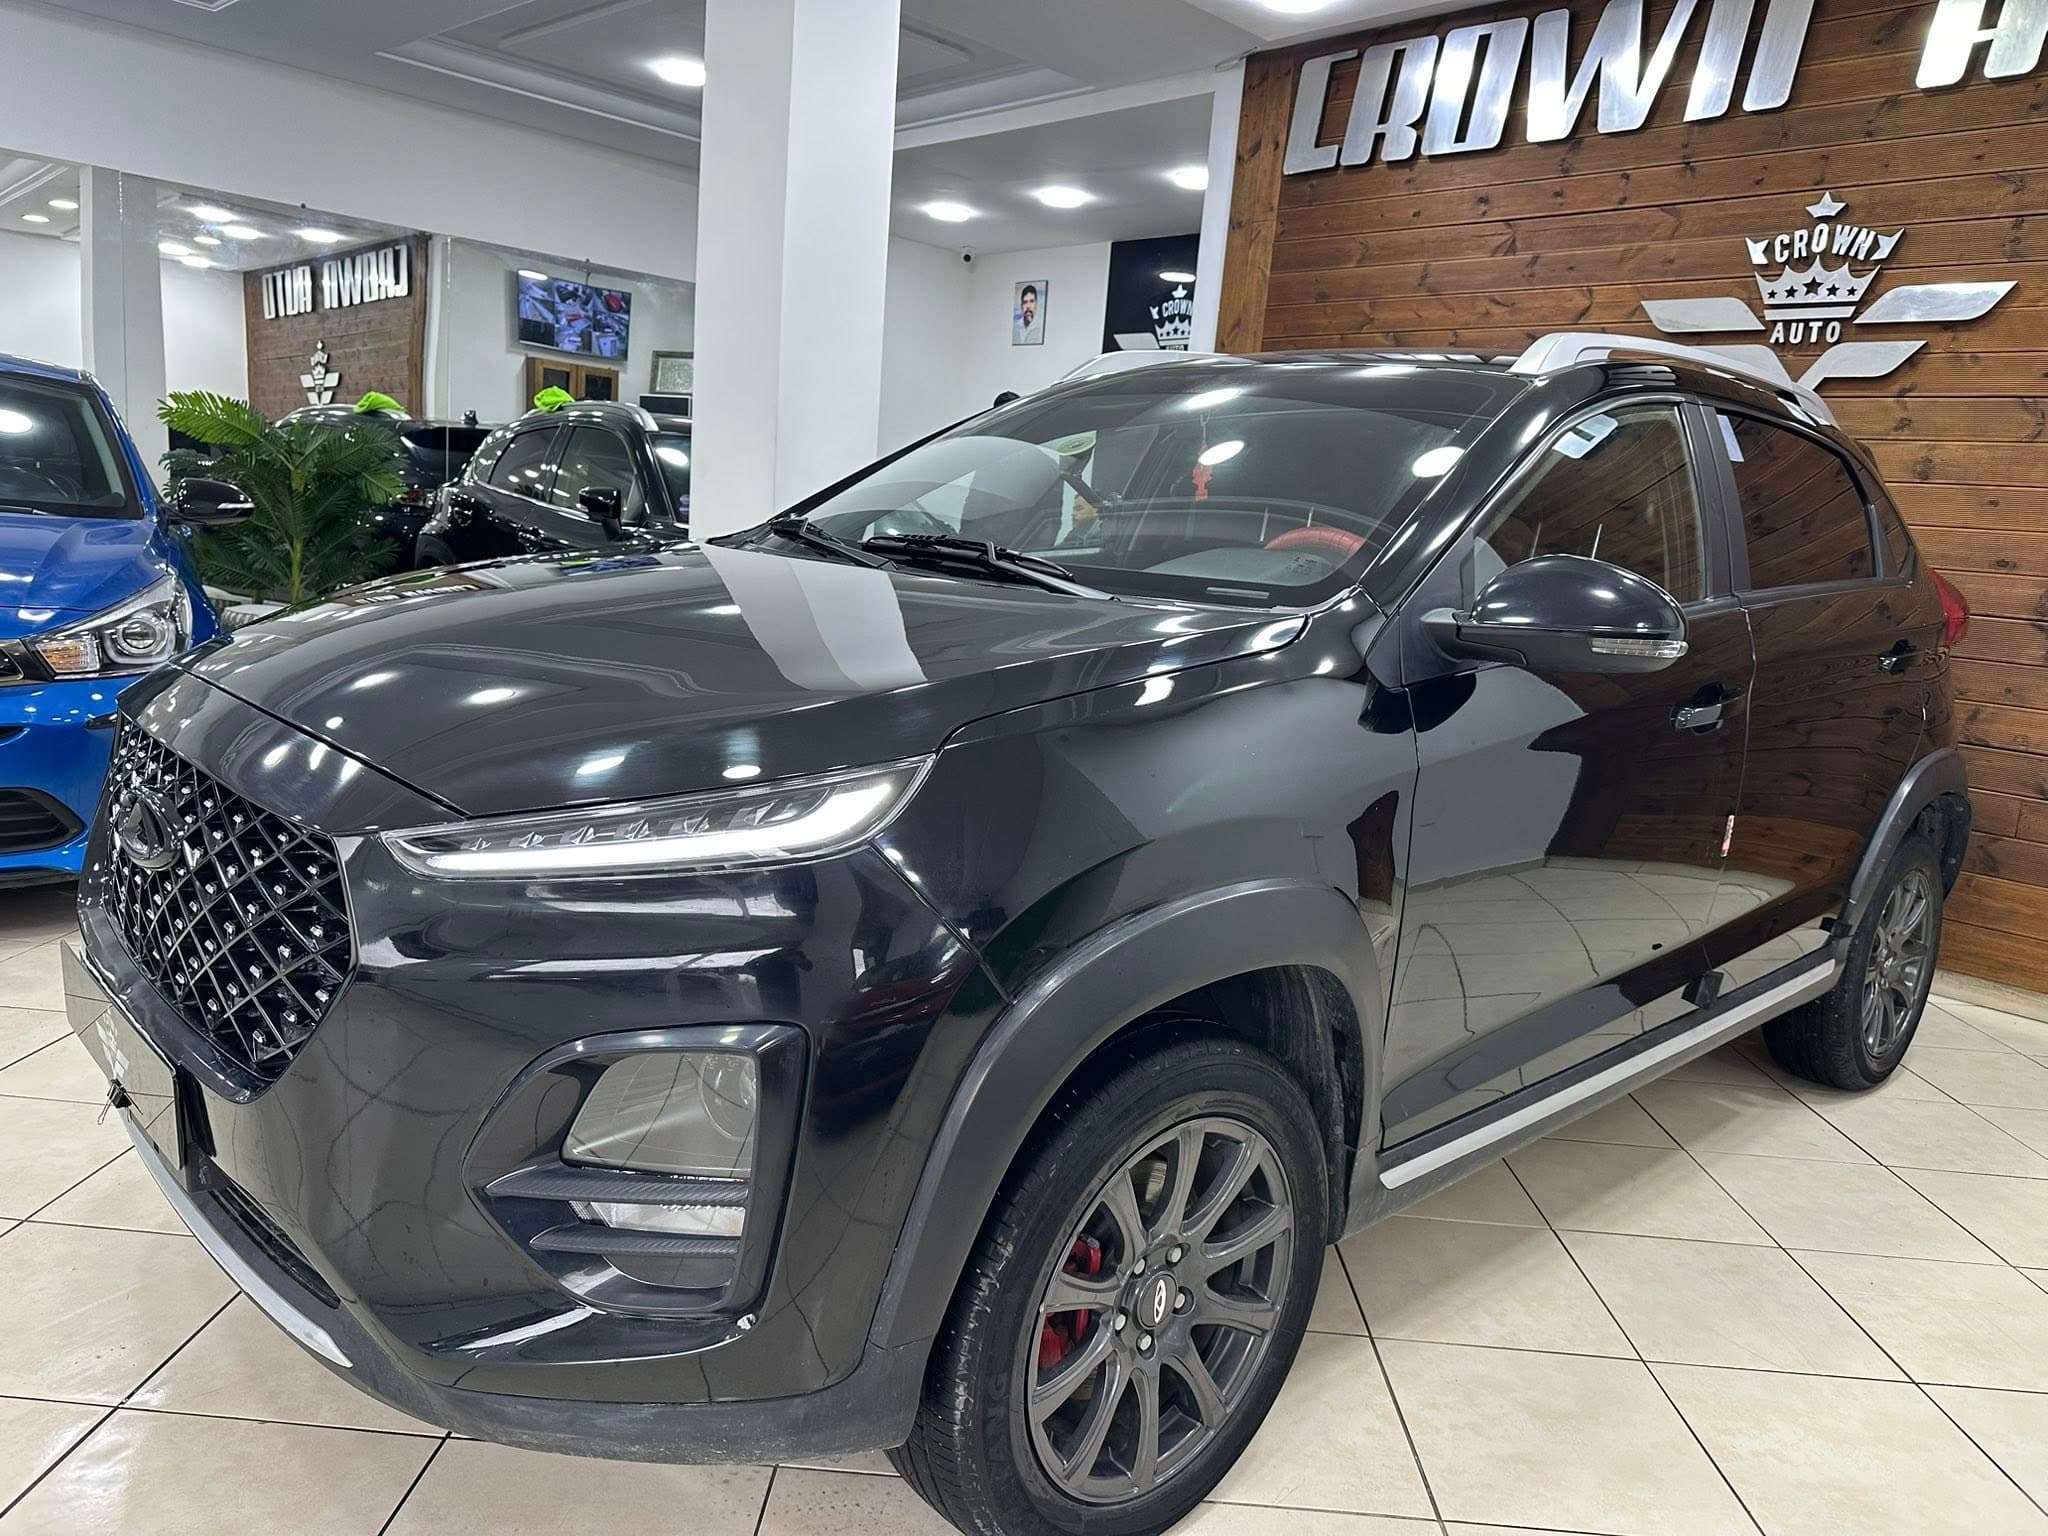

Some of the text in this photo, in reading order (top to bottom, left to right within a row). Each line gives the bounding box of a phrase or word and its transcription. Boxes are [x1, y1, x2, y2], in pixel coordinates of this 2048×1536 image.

[1283, 0, 1814, 175] CROWN
[1774, 223, 1876, 263] CROWN
[1769, 321, 1841, 344] AUTO
